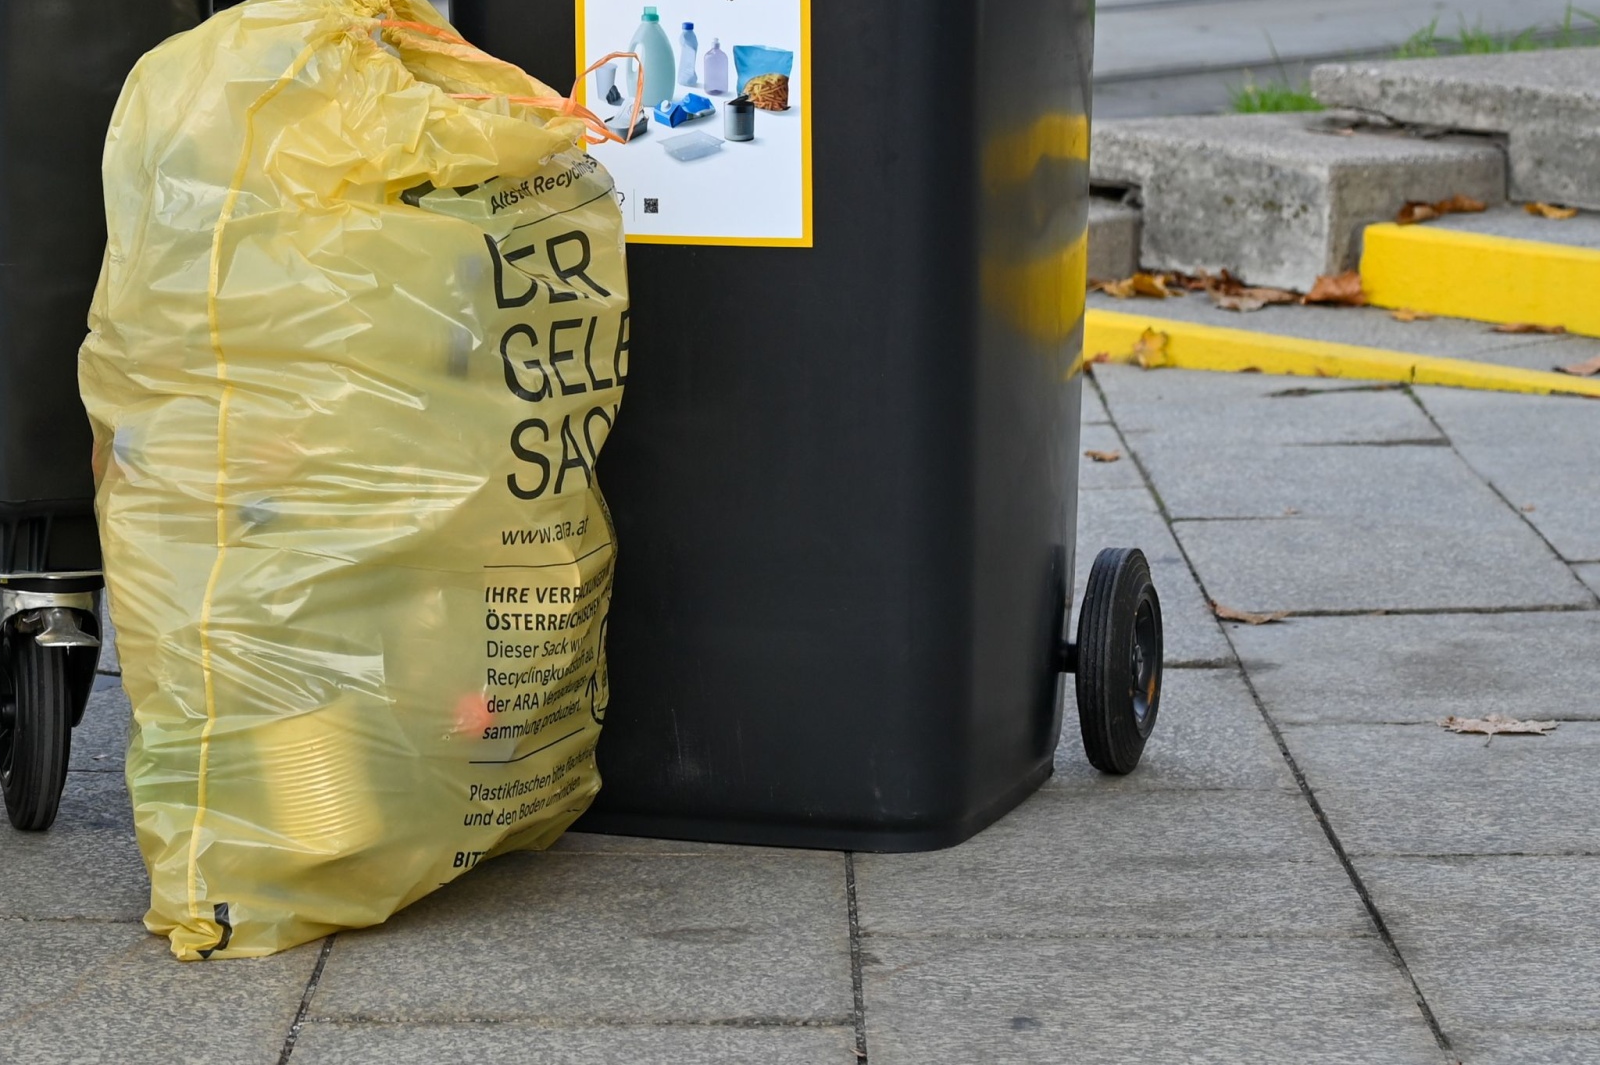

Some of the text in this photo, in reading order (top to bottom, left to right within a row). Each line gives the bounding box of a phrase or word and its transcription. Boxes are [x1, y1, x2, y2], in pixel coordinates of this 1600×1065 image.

[506, 403, 618, 502] SAC
[501, 514, 589, 546] www.ara.at
[485, 586, 530, 604] IHRE
[486, 639, 539, 659] Dieser
[541, 636, 568, 658] Sack
[486, 694, 511, 714] der
[512, 692, 540, 712] ARA
[482, 719, 543, 740] sammlung
[469, 772, 552, 802] Plastikflaschen
[463, 808, 494, 827] und
[496, 807, 518, 826] den
[518, 796, 546, 821] Boden
